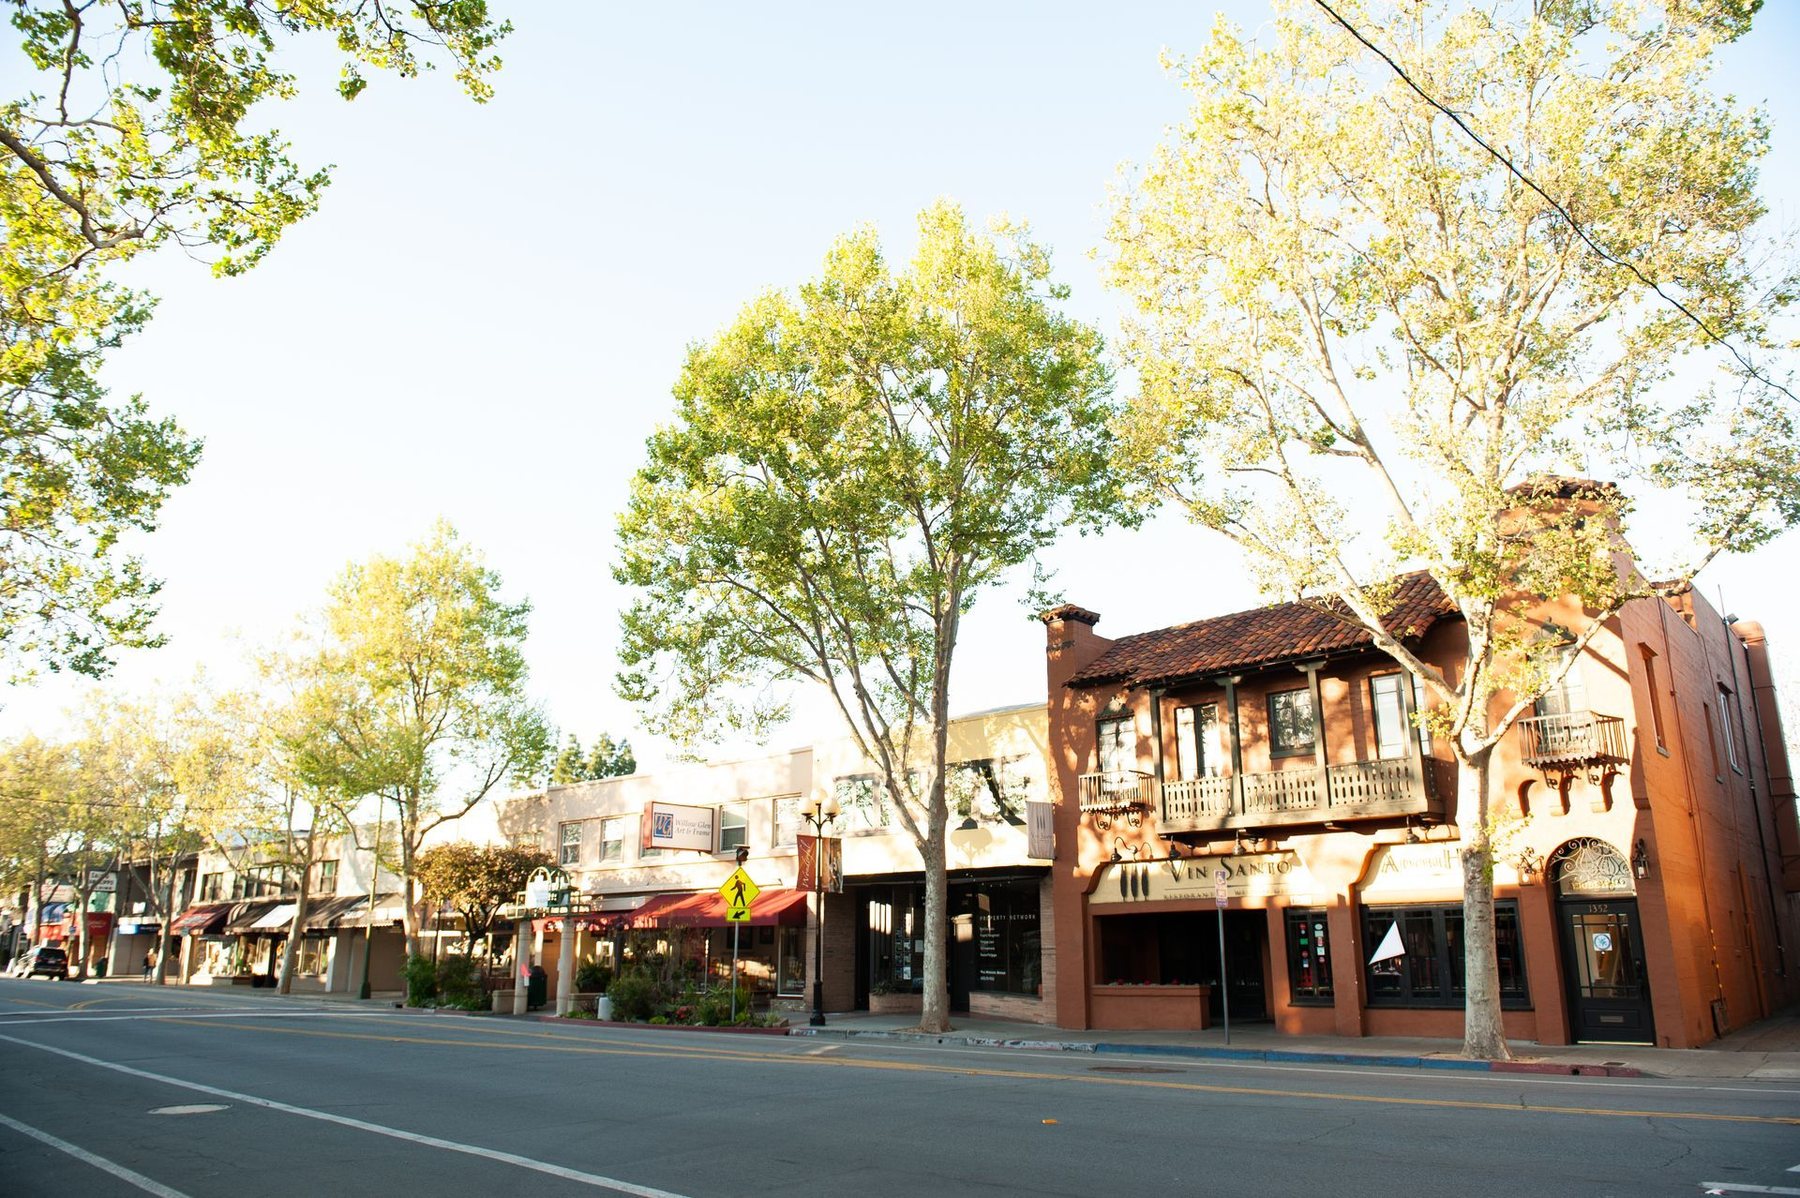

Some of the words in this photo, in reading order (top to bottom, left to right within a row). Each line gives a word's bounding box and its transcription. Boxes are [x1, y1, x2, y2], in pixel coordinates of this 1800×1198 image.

[675, 818, 696, 828] Willow
[697, 821, 711, 829] Glen
[674, 826, 685, 834] Art
[692, 828, 711, 836] Frame
[1166, 859, 1208, 882] VIN
[1220, 856, 1291, 881] SANTO
[1588, 904, 1609, 913] 1352
